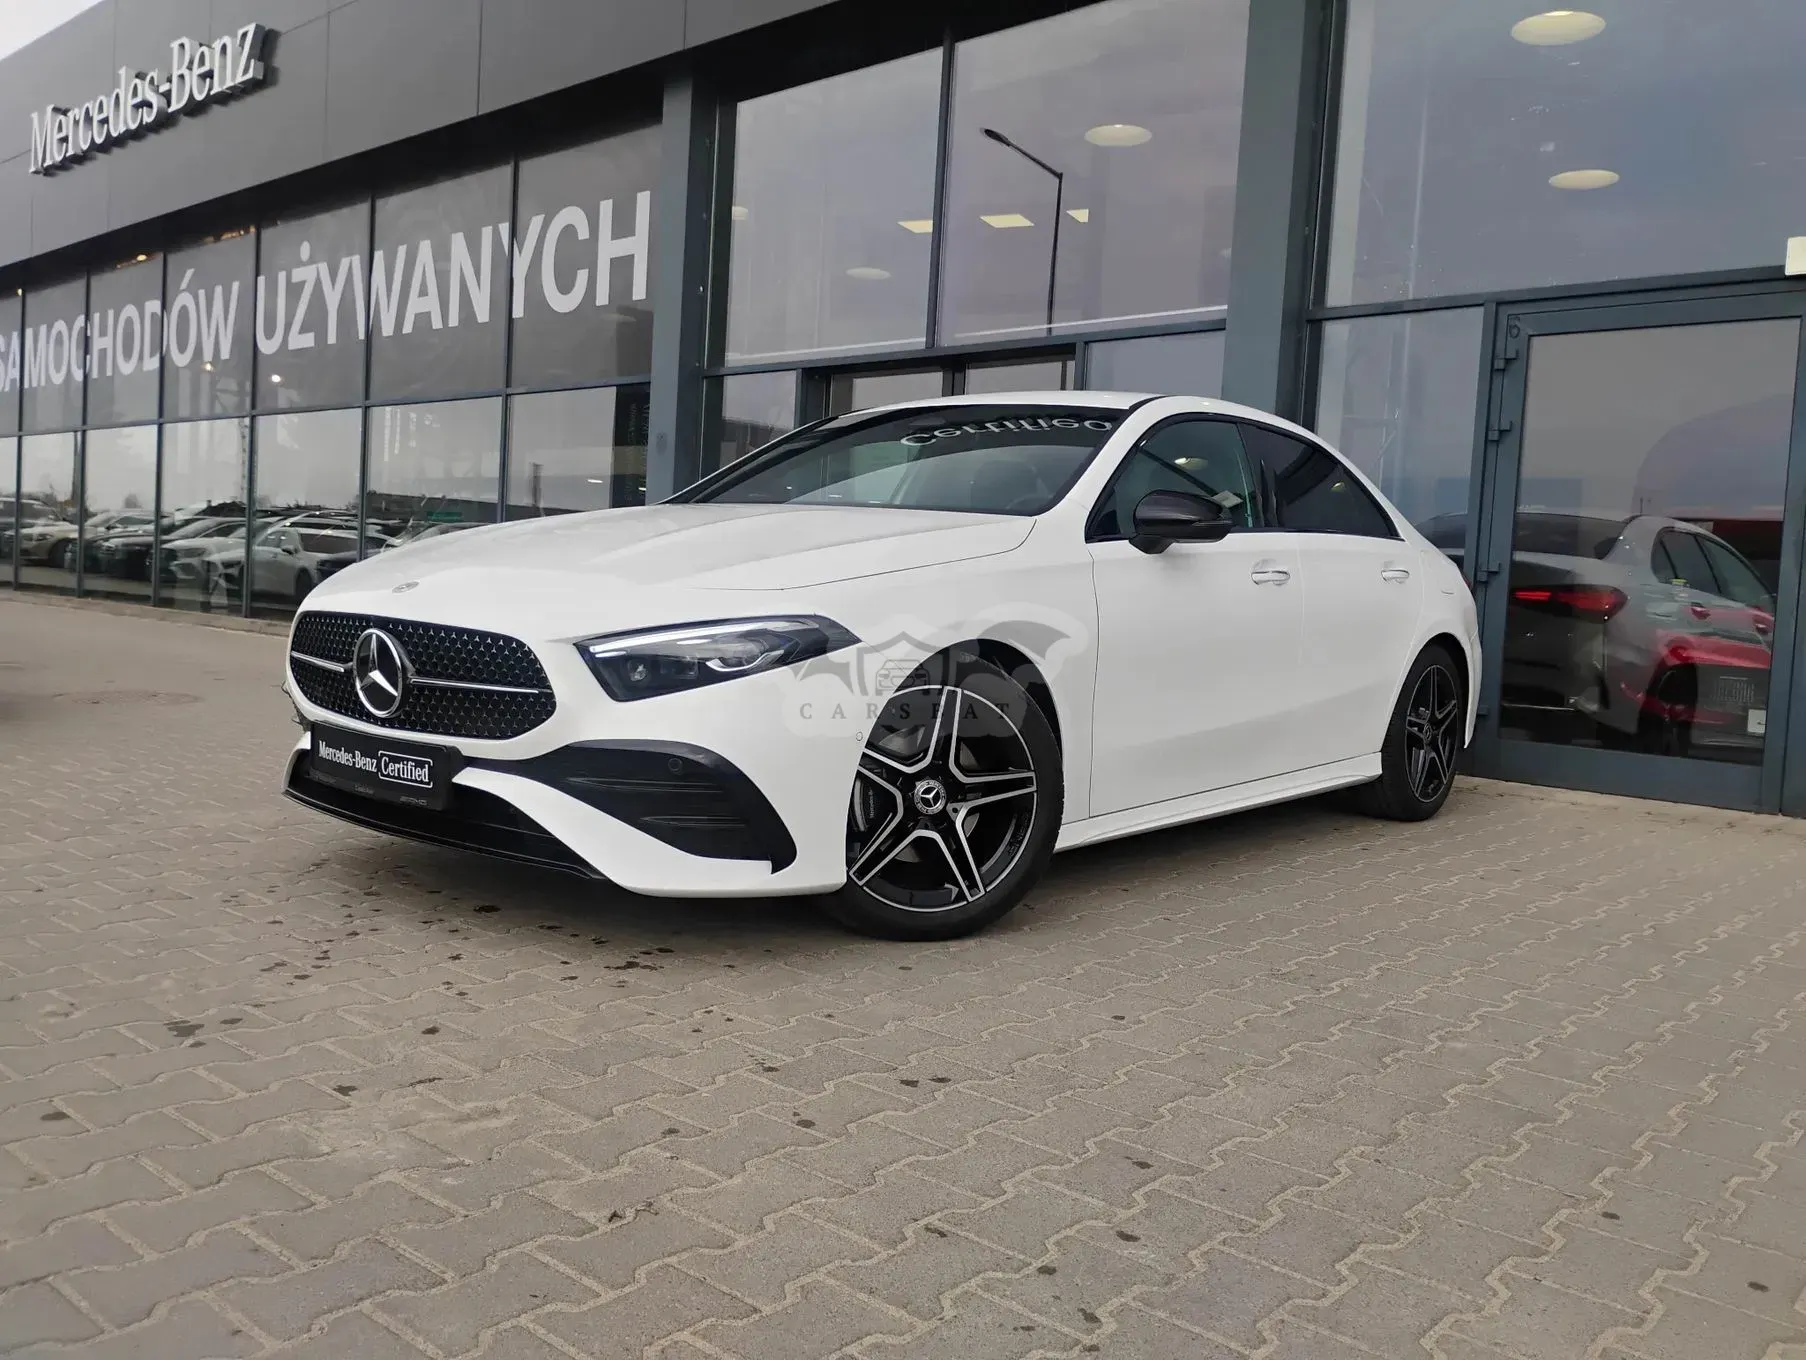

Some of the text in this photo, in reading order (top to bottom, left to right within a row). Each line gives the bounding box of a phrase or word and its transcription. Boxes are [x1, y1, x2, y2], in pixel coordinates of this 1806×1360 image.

[29, 22, 266, 175] Mercedes-Benz
[256, 191, 650, 355] UŻYWANYCH
[318, 740, 429, 782] Mercedes-Benz Certified
